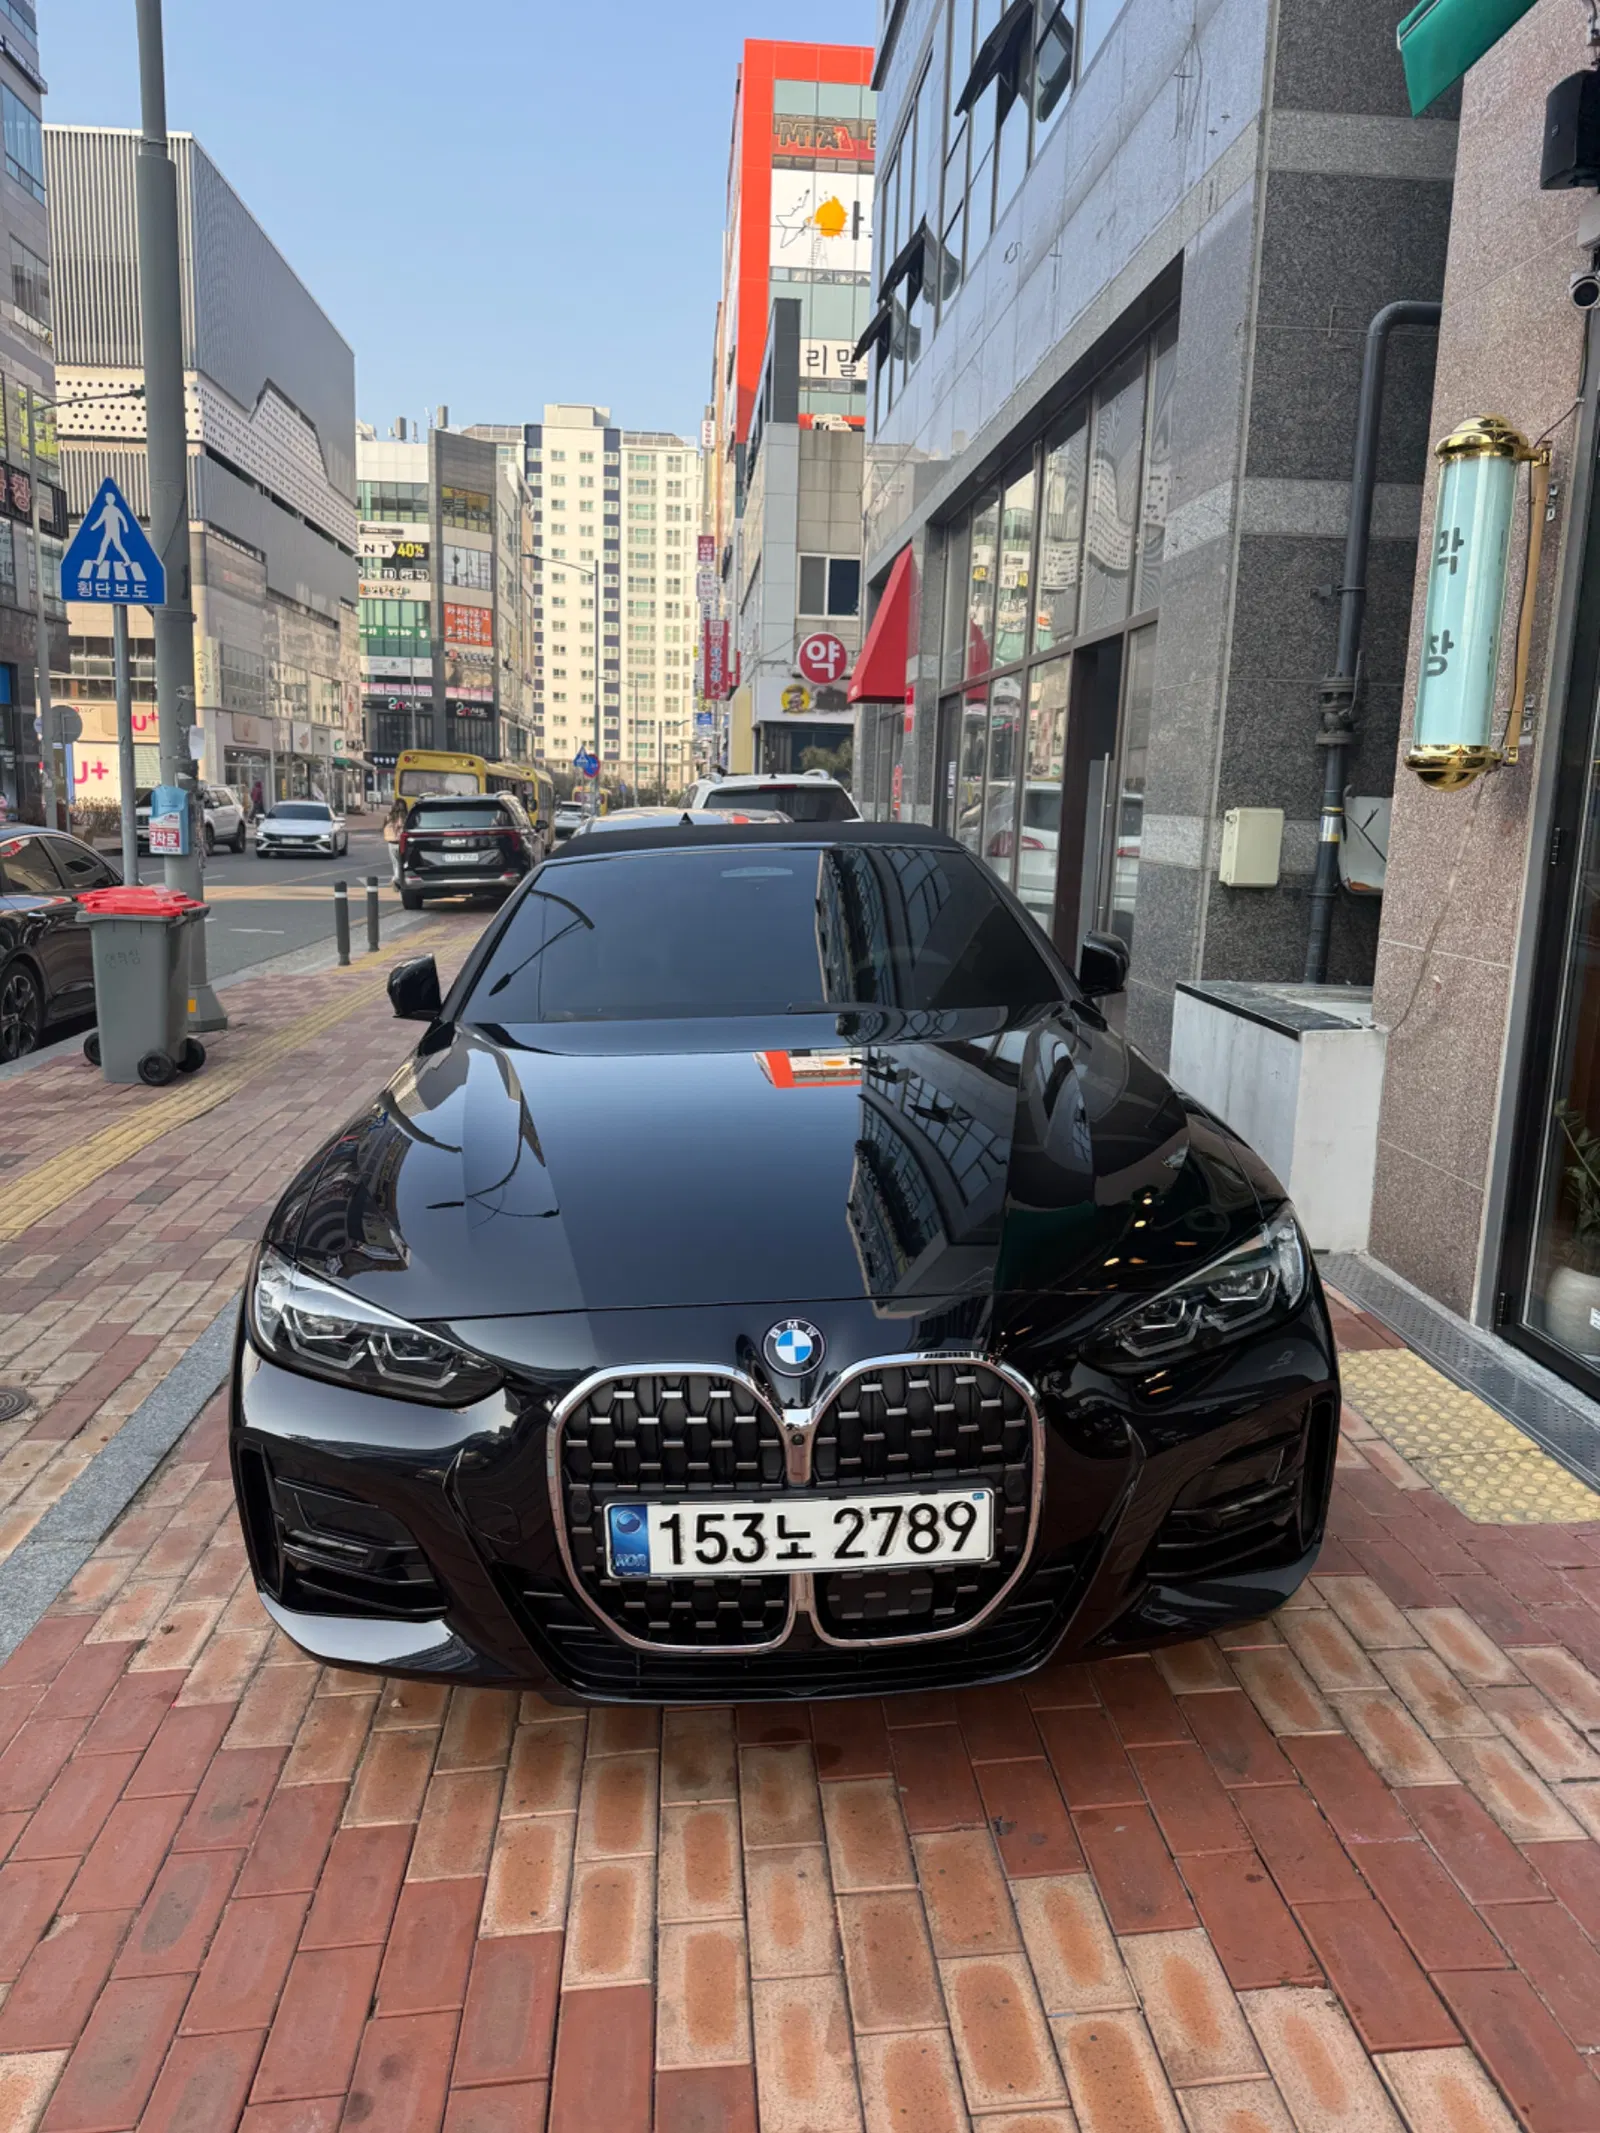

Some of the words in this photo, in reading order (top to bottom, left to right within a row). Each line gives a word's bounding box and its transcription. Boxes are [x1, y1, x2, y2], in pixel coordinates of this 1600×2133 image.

[77, 581, 149, 598] 횡단보도
[806, 640, 841, 680] 약
[769, 1320, 820, 1338] BMW
[660, 1513, 814, 1564] 153노
[833, 1500, 977, 1558] 2789
